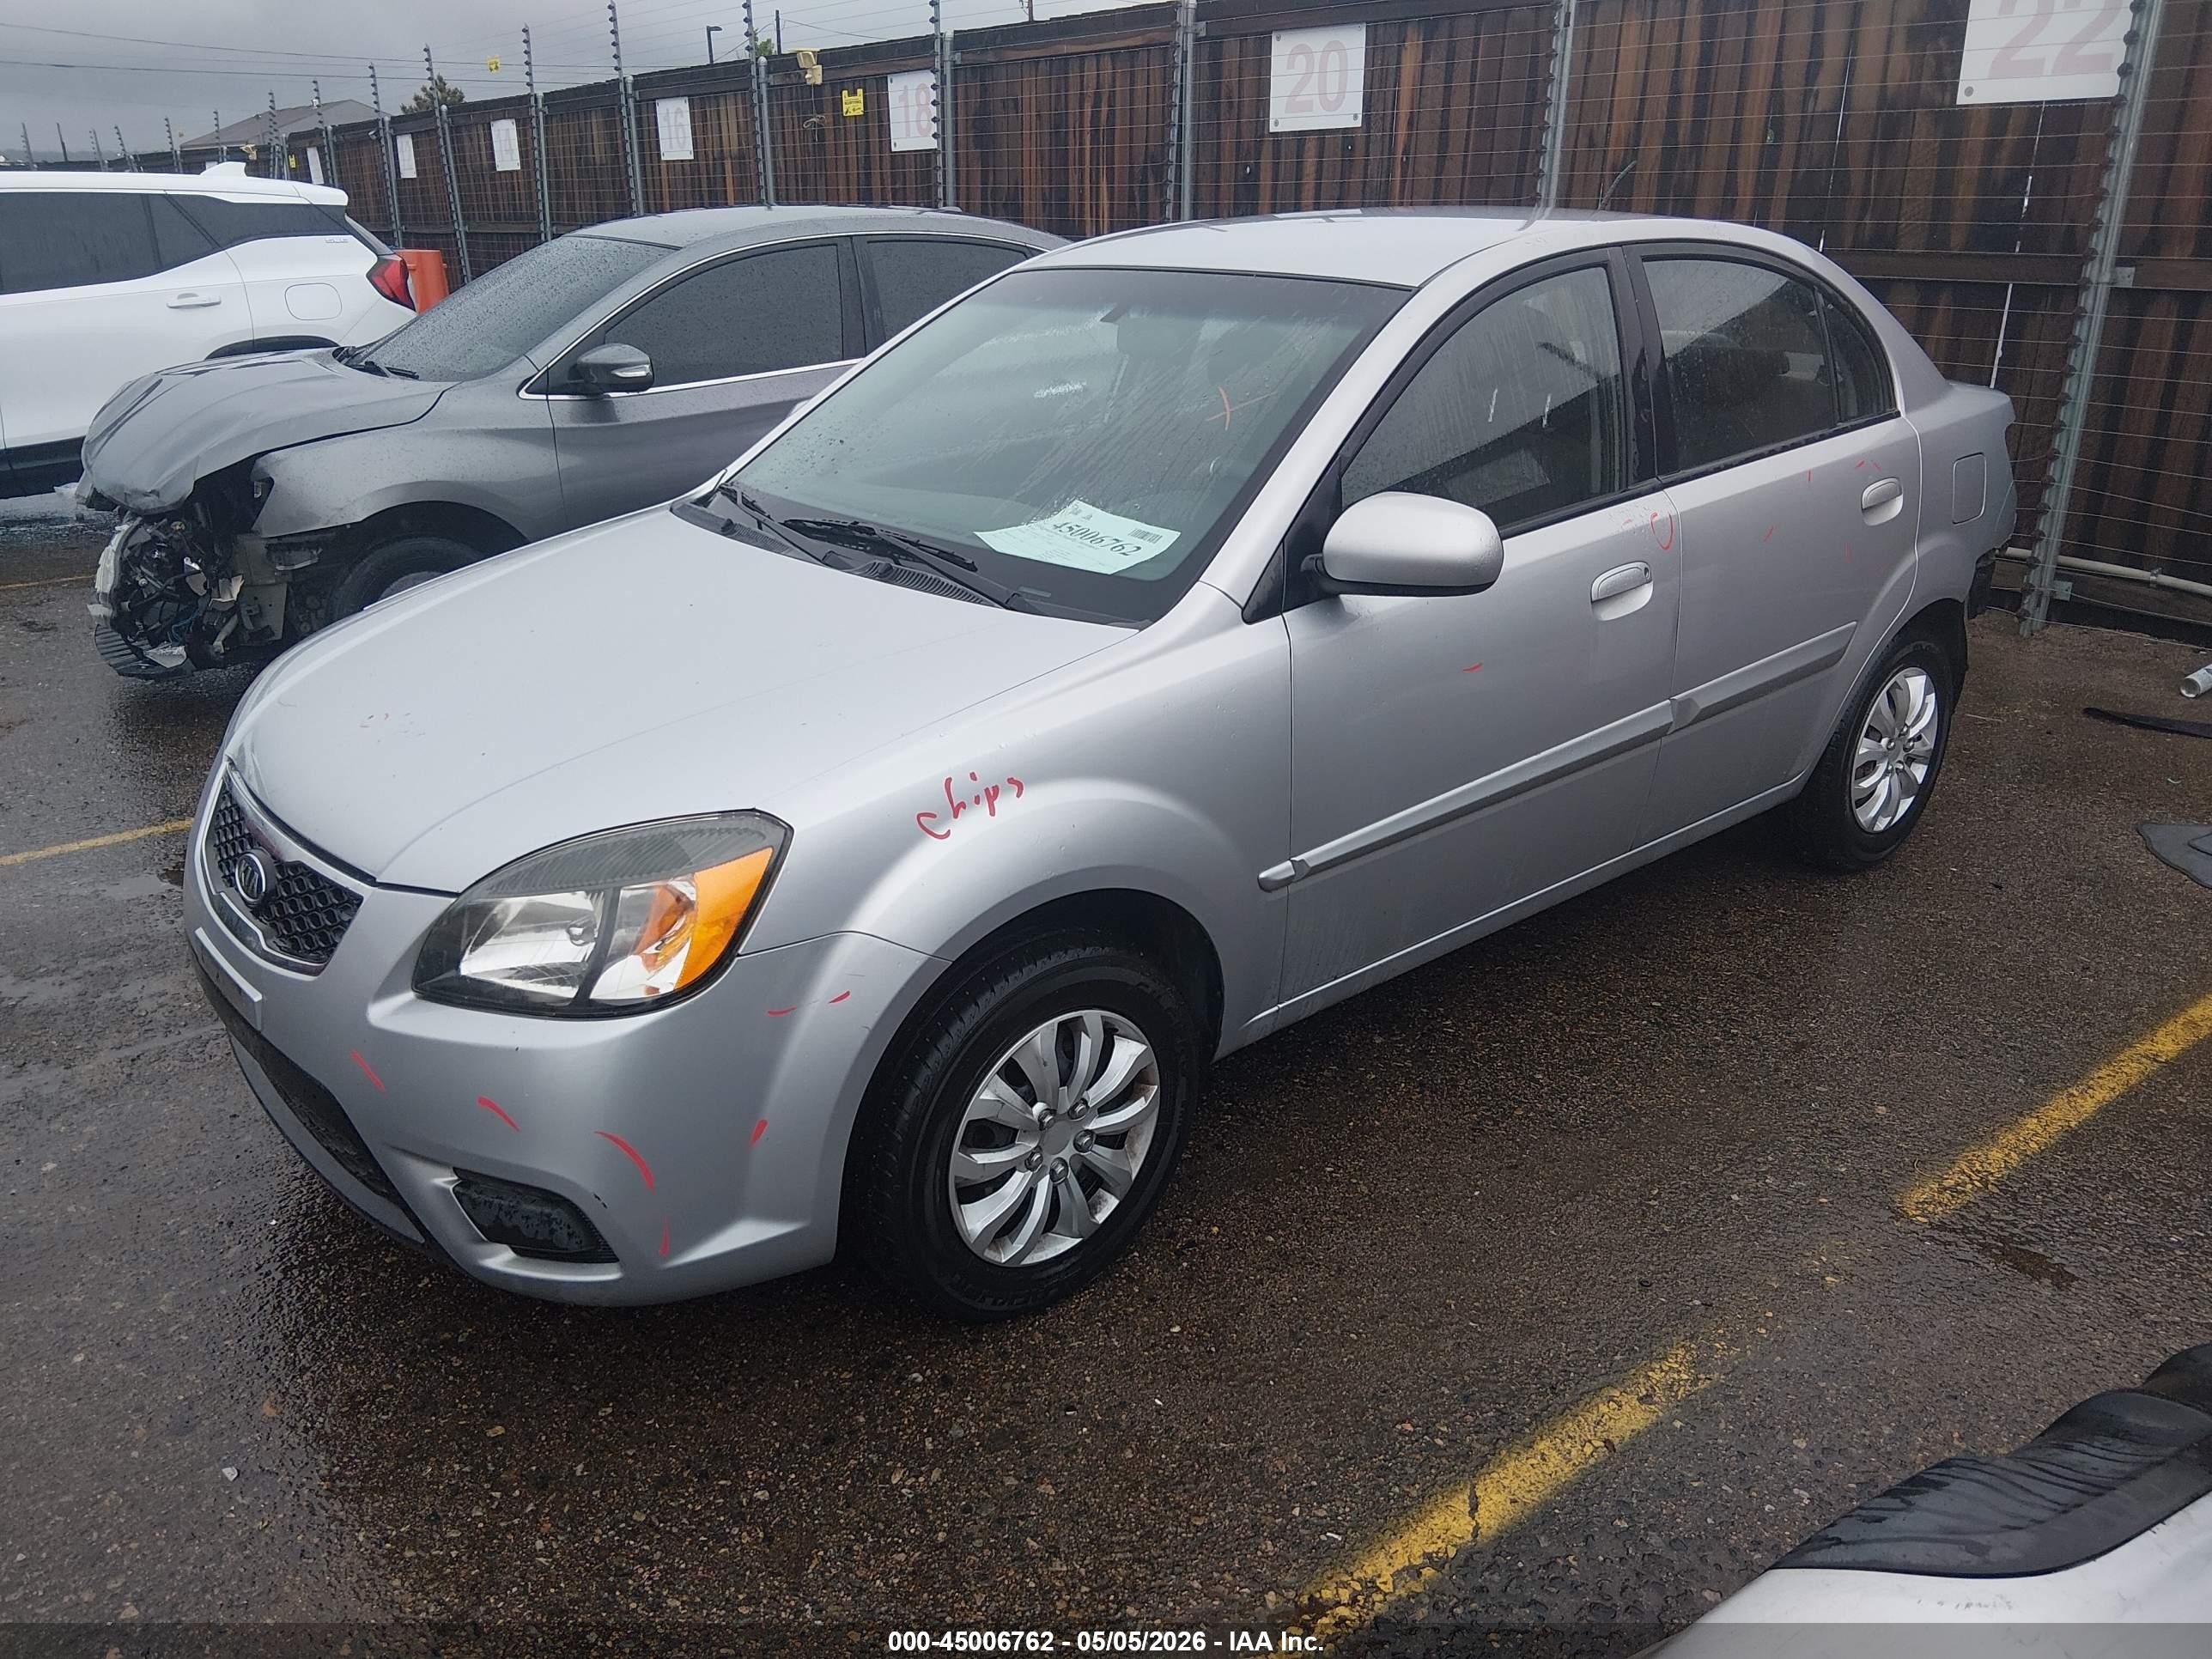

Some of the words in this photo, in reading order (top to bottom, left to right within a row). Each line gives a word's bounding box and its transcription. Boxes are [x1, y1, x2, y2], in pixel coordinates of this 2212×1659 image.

[1986, 0, 2124, 78] 22
[1285, 40, 1349, 113] 20
[664, 107, 686, 149] 16
[899, 83, 933, 137] 18
[1053, 521, 1142, 556] 45006762
